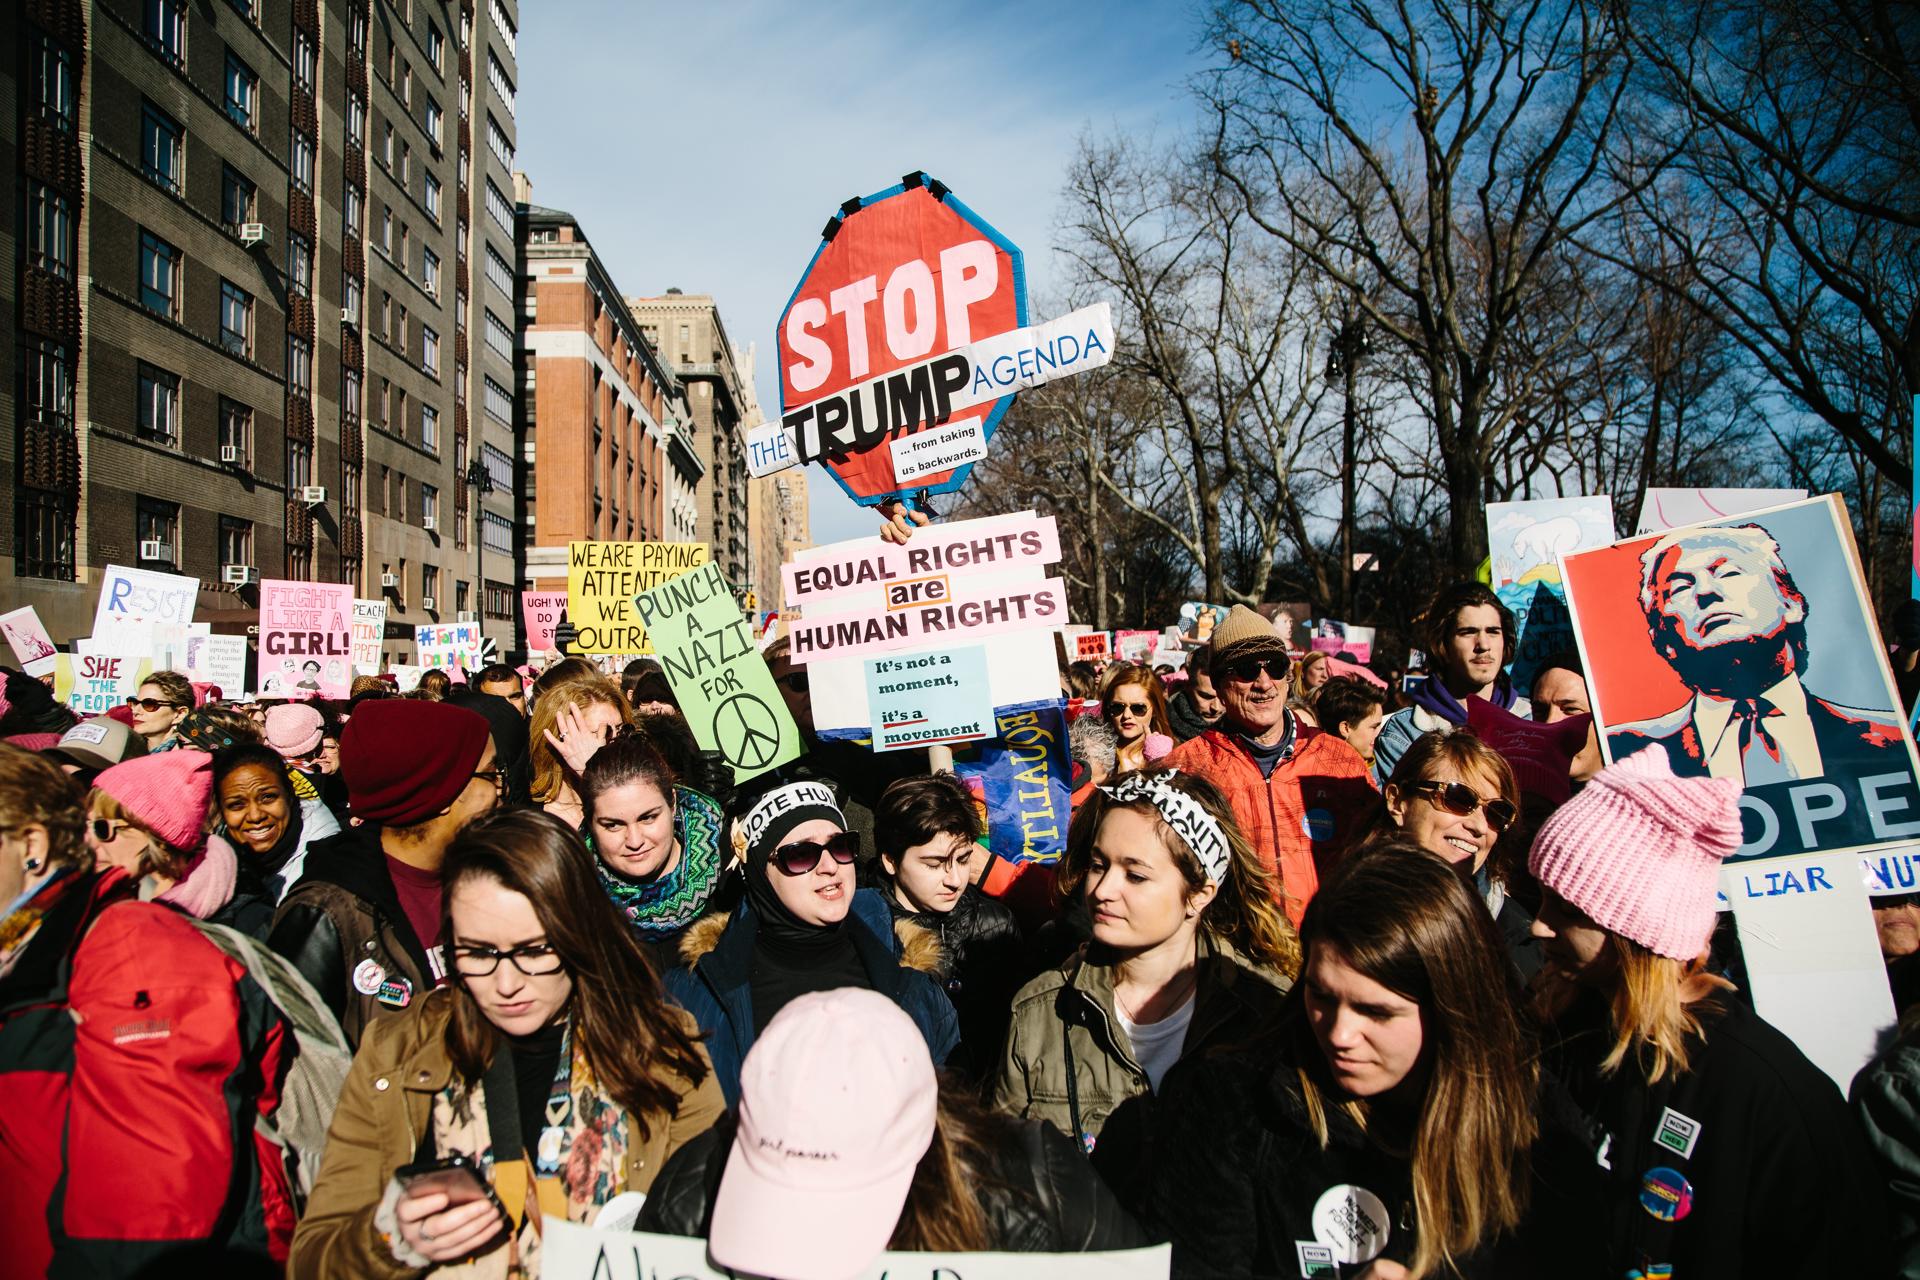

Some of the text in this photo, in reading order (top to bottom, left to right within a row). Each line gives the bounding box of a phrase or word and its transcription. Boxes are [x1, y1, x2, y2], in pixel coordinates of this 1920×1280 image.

[786, 239, 999, 392] STOP
[750, 328, 1107, 468] THE TRUMP AGENDA
[912, 438, 938, 451] from
[940, 427, 975, 443] taking
[902, 448, 981, 476] us backwards.
[571, 543, 704, 568] WE ARE PAYING
[794, 530, 1043, 595] EQUAL RIGHTS
[108, 578, 193, 623] RESIST
[267, 586, 343, 610] FIGHT
[527, 598, 568, 608] UGH! W
[635, 564, 727, 627] PUNCH
[891, 578, 945, 604] are
[267, 609, 344, 631] LIKE A
[353, 603, 384, 618] PEACH
[537, 613, 552, 623] DO
[598, 600, 629, 621] WE
[795, 590, 1057, 653] HUMAN RIGHTS
[542, 629, 556, 638] ST
[687, 612, 703, 638] A
[266, 631, 350, 656] GIRL!
[354, 643, 381, 664] PPET
[662, 619, 754, 687] NAZI
[80, 655, 122, 679] SHE
[875, 655, 951, 674] It's not a
[88, 679, 118, 693] THE
[700, 667, 743, 702] FOR
[878, 674, 959, 694] moment,
[71, 693, 124, 711] PEOPL
[882, 710, 923, 723] it's a
[884, 721, 980, 743] movement
[743, 793, 791, 839] VOTE
[1735, 771, 1920, 856] OPE
[1744, 866, 1834, 898] LIAR
